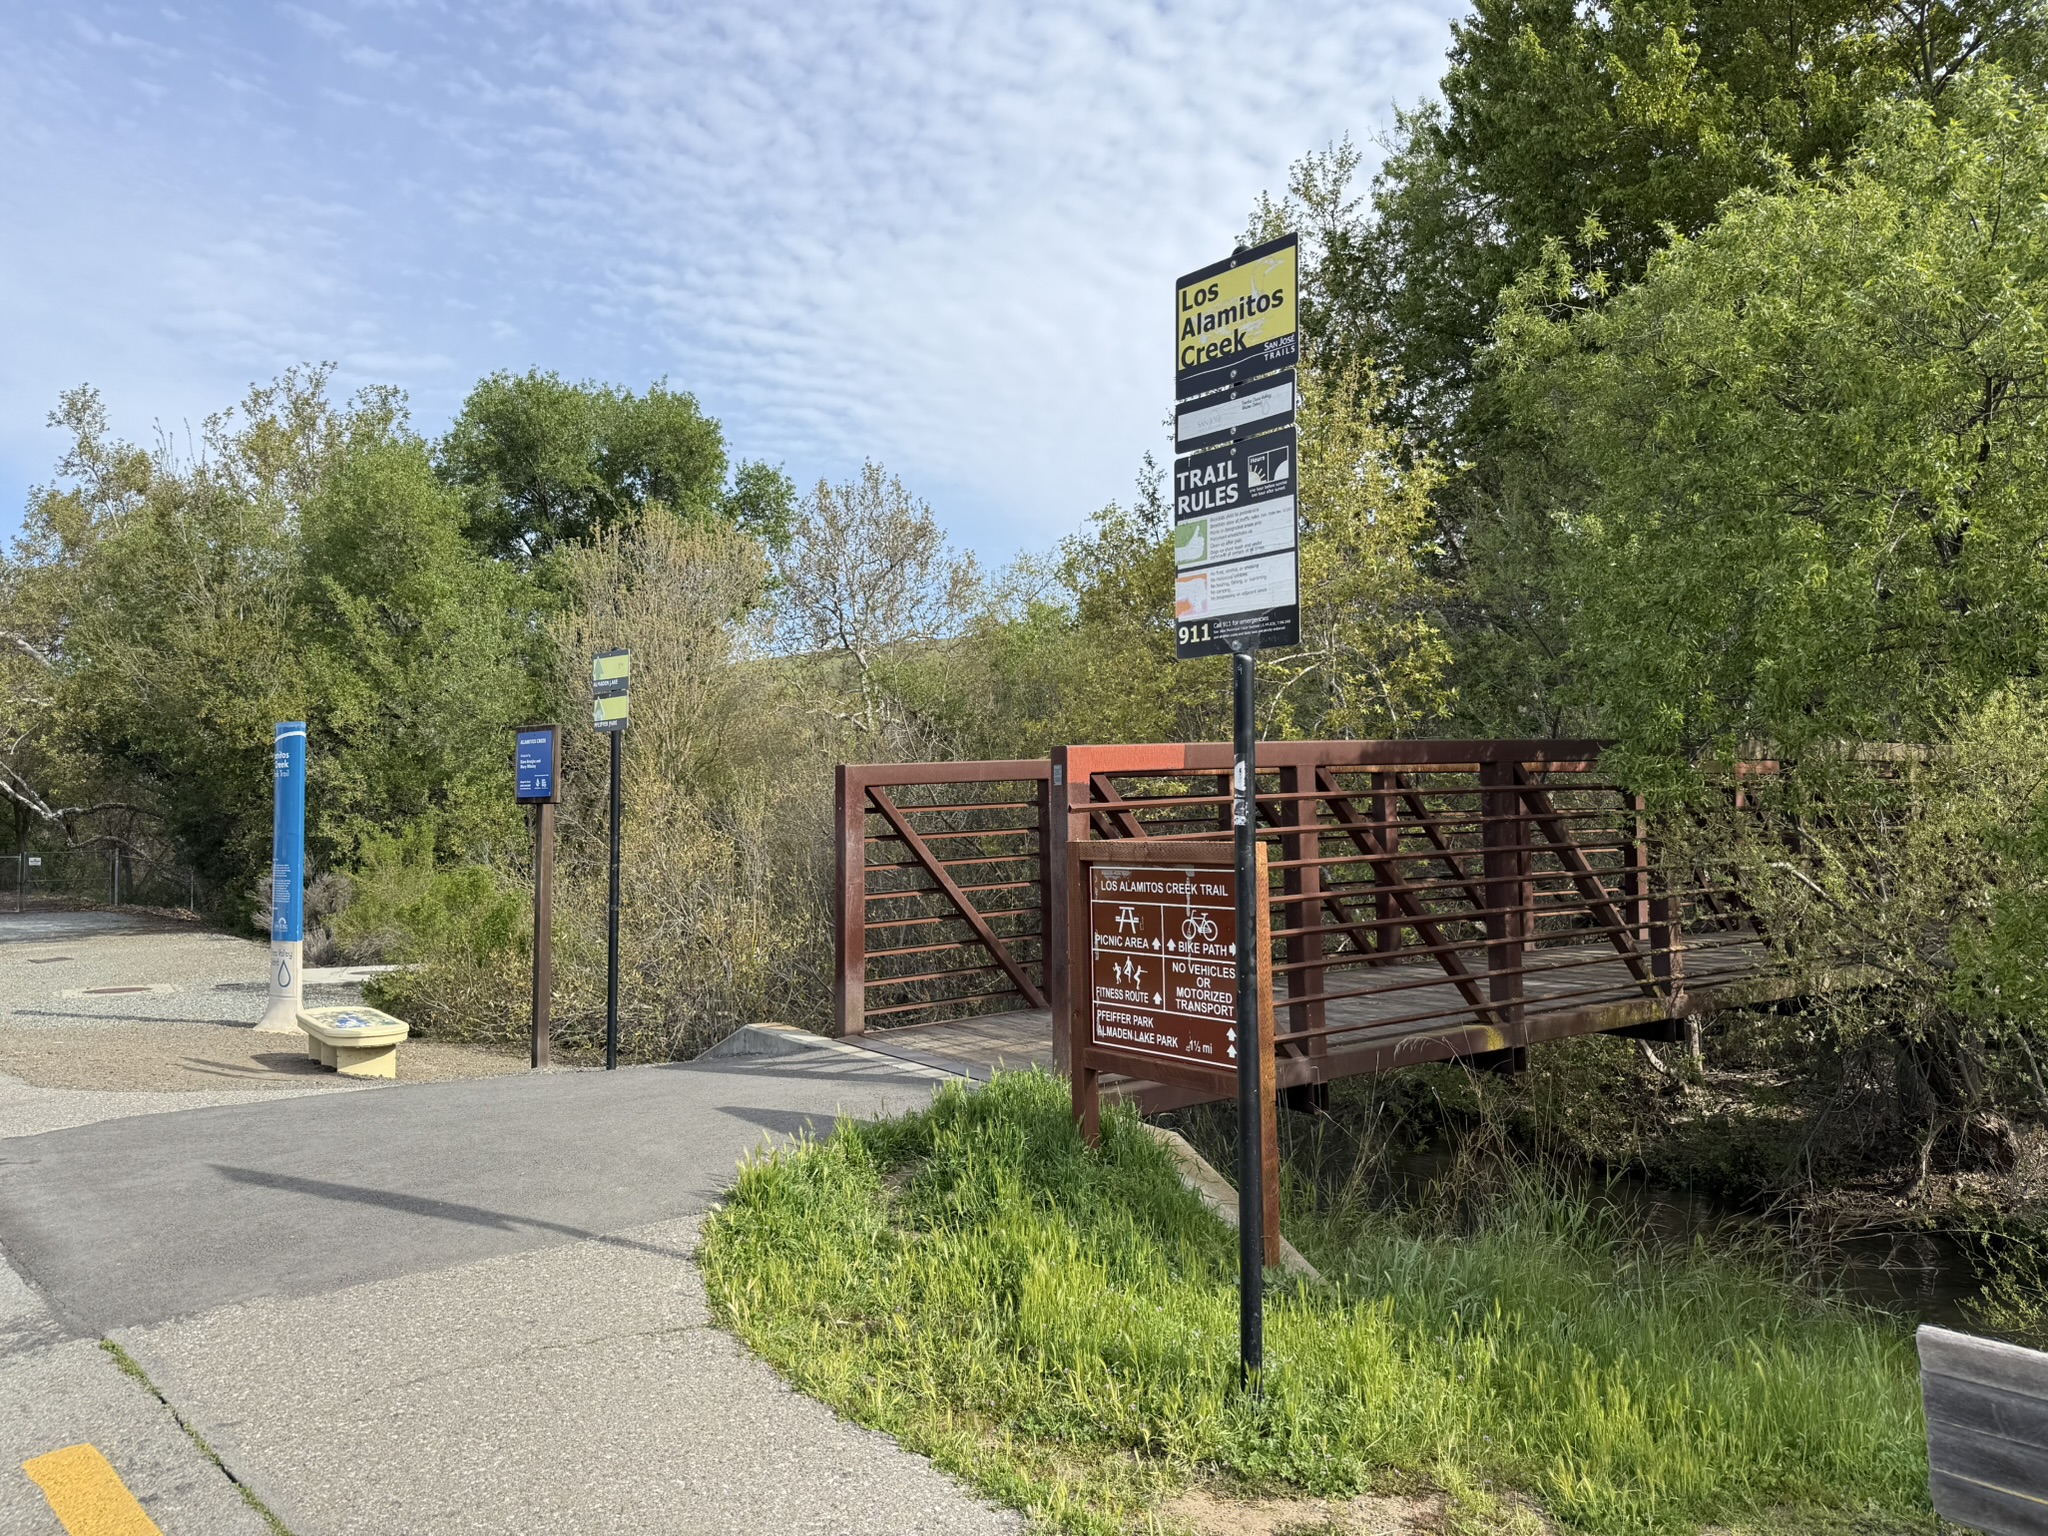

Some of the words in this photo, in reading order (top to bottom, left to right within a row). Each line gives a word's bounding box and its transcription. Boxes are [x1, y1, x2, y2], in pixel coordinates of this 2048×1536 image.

[1182, 283, 1219, 312] Los
[1181, 288, 1284, 342] Alamitos
[1181, 328, 1248, 369] Creek
[1264, 345, 1295, 361] TRAILS
[1177, 460, 1238, 492] TRAIL
[1178, 483, 1239, 515] RULES
[1239, 616, 1269, 625] emergencies
[1178, 623, 1212, 645] 911
[1100, 880, 1118, 892] LOS
[1119, 881, 1164, 893] ALAMITOS
[1166, 883, 1198, 895] CREEK
[1200, 884, 1228, 897] TRAIL
[1095, 934, 1123, 946] PICNIC
[1124, 936, 1149, 949] AREA
[1178, 941, 1200, 954] BIKE
[1202, 944, 1228, 956] PATH
[1172, 962, 1186, 973] NO
[1188, 963, 1236, 979] VEHICLES
[1196, 977, 1211, 988] OR
[1096, 986, 1123, 1000] FITNESS
[1125, 990, 1149, 1003] ROUTE
[1176, 987, 1233, 1004] MOTORIZED
[1176, 999, 1234, 1017] TRANSPORT
[1097, 1009, 1131, 1025] PFEIFFER
[1133, 1014, 1154, 1028] PARK
[1097, 1025, 1132, 1040] ALMADEN
[1134, 1030, 1155, 1044] LAKE
[1156, 1036, 1178, 1048] PARK
[1202, 1043, 1213, 1054] mi
